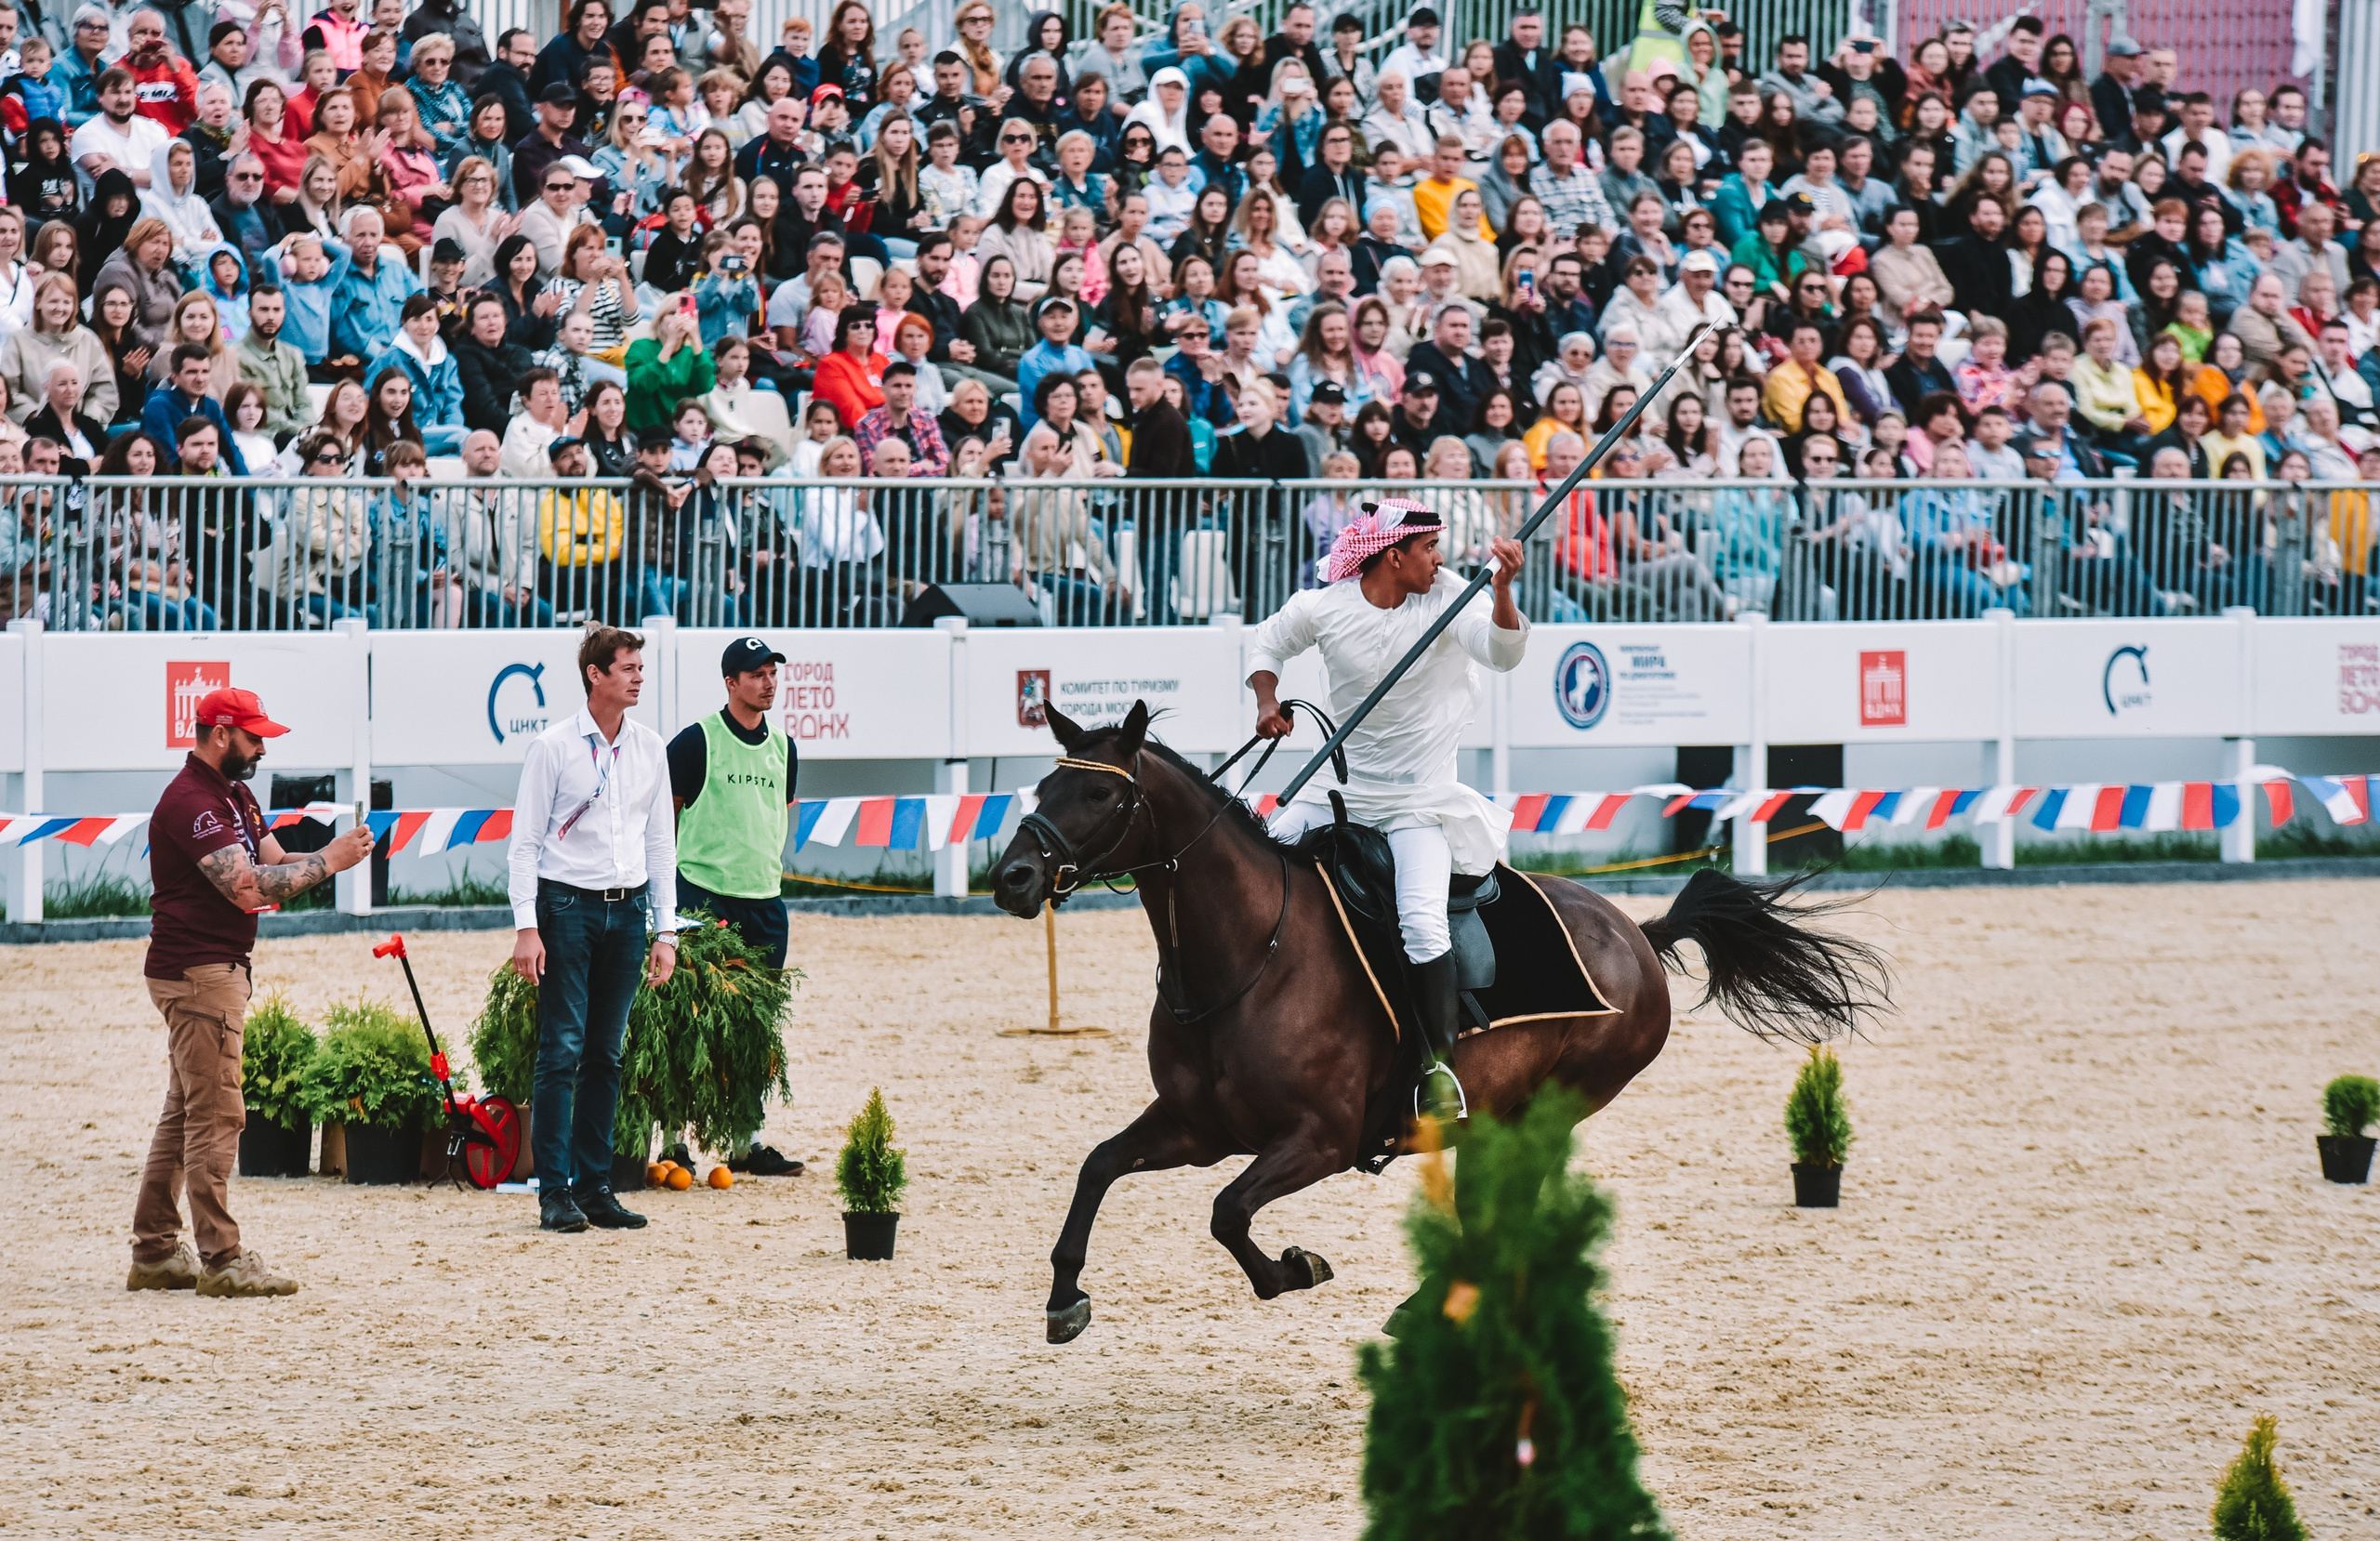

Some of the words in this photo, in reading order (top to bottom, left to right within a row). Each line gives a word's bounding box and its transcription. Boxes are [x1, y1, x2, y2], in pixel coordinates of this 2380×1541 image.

[784, 662, 834, 683] ГОРОД
[1060, 681, 1110, 695] КОМИТЕТ
[1112, 680, 1128, 694] ПО
[1130, 678, 1179, 693] ТУРИЗМУ
[783, 686, 835, 710] ЛЕТО
[1060, 703, 1102, 716] ГОРОДА
[174, 718, 197, 739] ВД
[509, 718, 549, 734] ЦНКТ
[727, 773, 774, 789] KIPSTA
